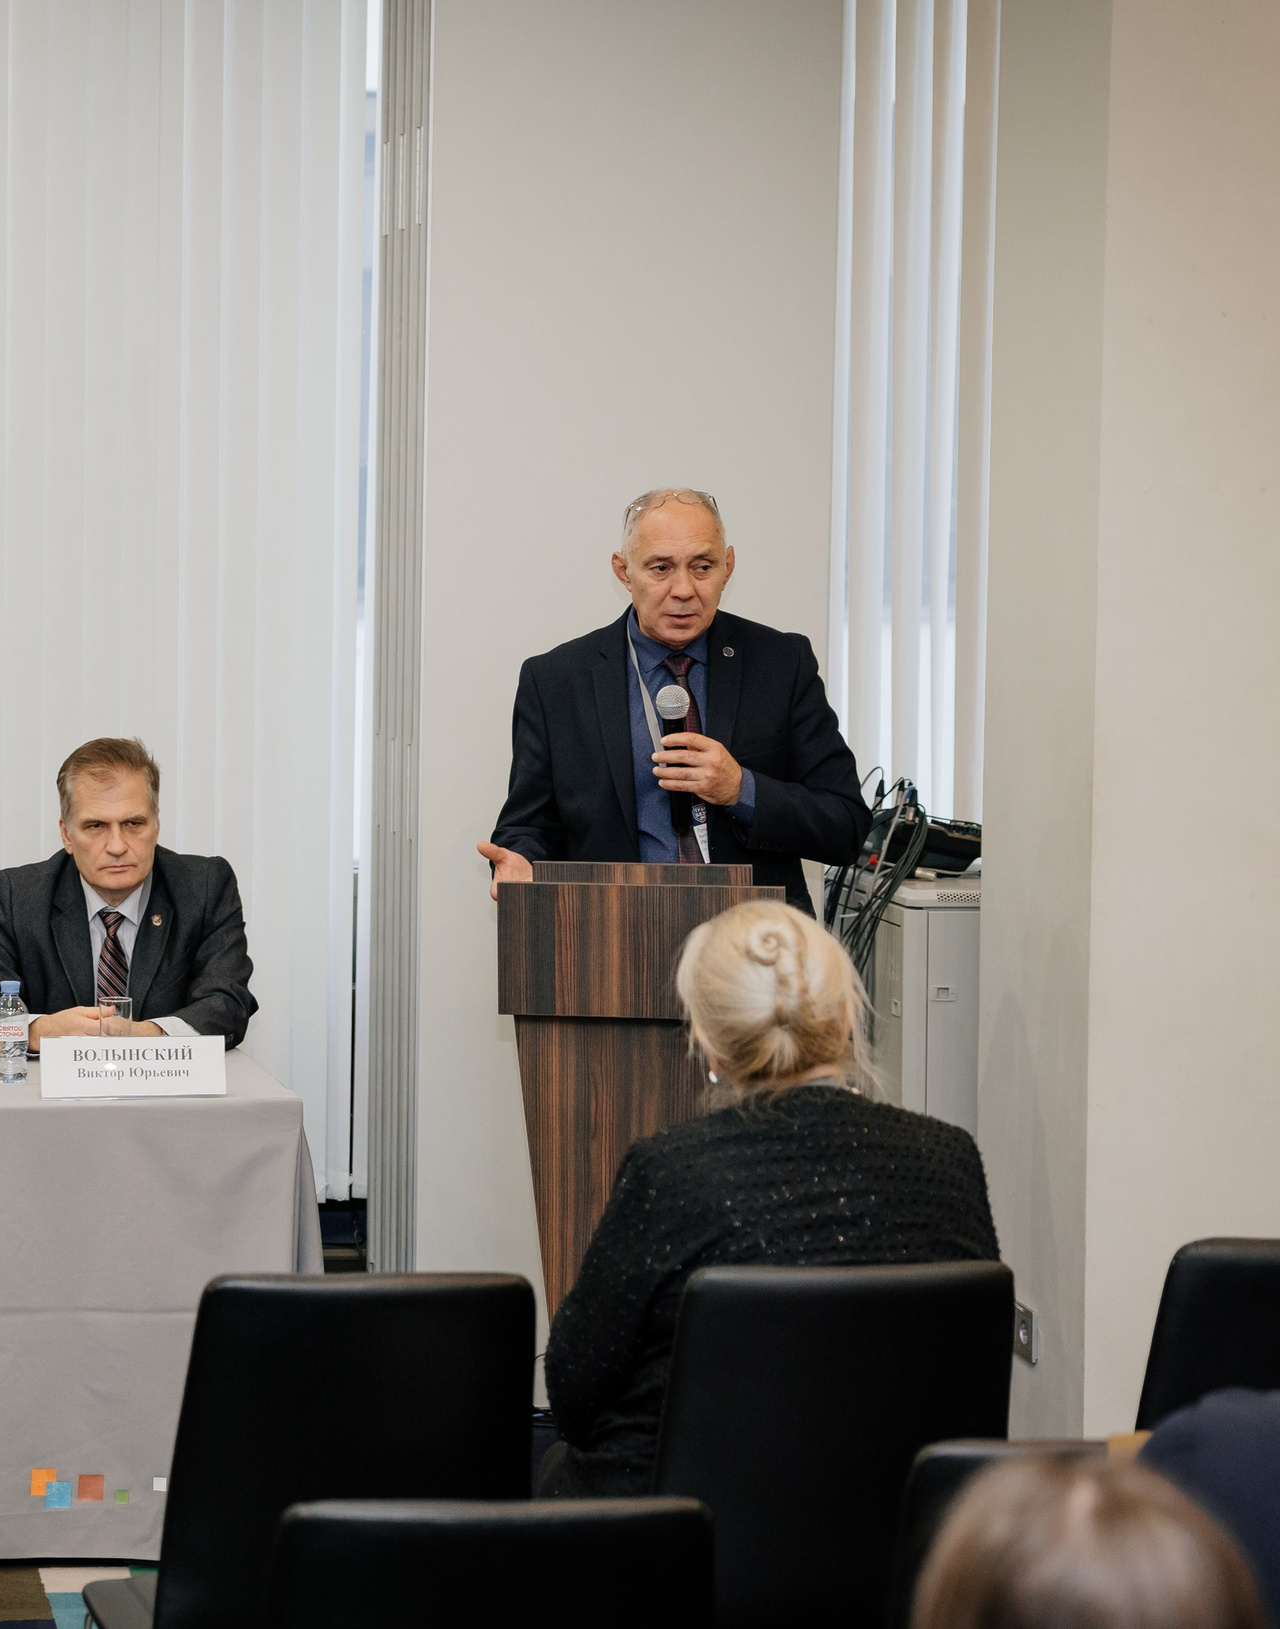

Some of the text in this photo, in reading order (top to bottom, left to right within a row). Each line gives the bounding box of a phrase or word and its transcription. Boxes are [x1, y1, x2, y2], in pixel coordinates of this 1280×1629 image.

[73, 1045, 193, 1062] ВОЛЫНСКИЙ
[77, 1067, 190, 1081] Виктор Юрьевич
